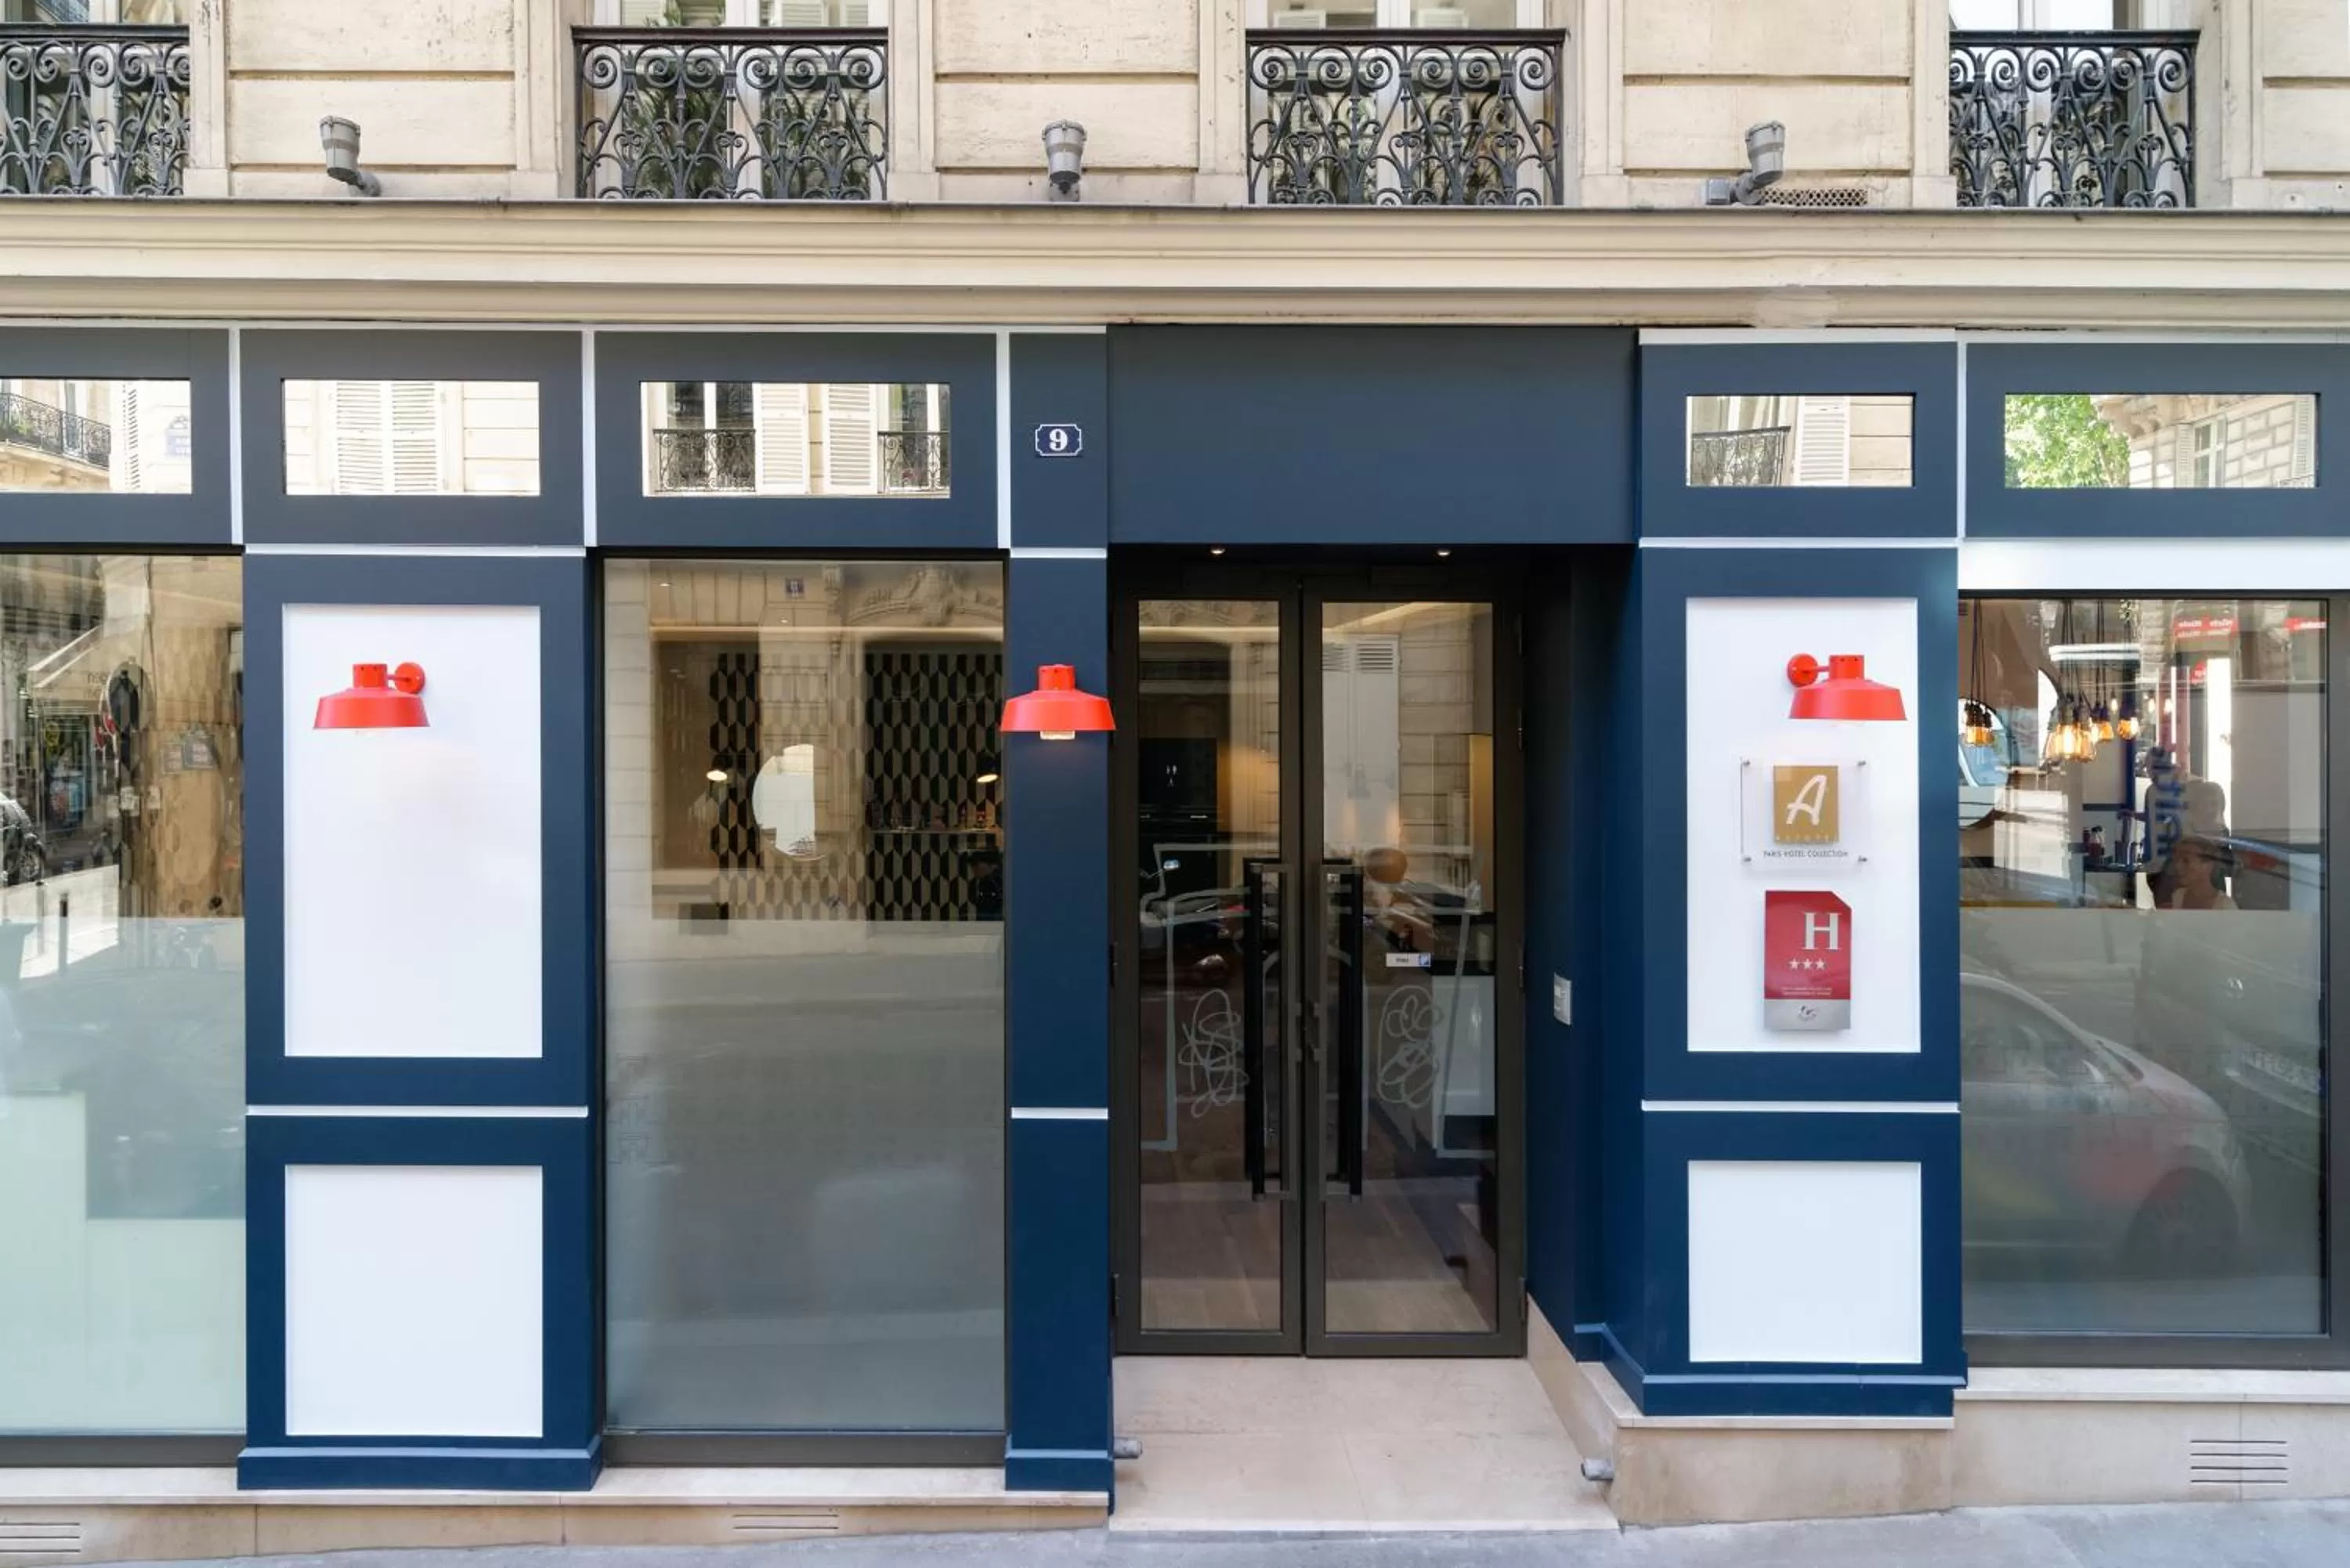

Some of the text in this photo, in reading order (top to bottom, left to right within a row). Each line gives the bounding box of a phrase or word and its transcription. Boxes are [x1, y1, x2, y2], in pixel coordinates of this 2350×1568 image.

[1049, 428, 1068, 451] 9
[1786, 775, 1827, 825] A
[1803, 912, 1842, 950] H
